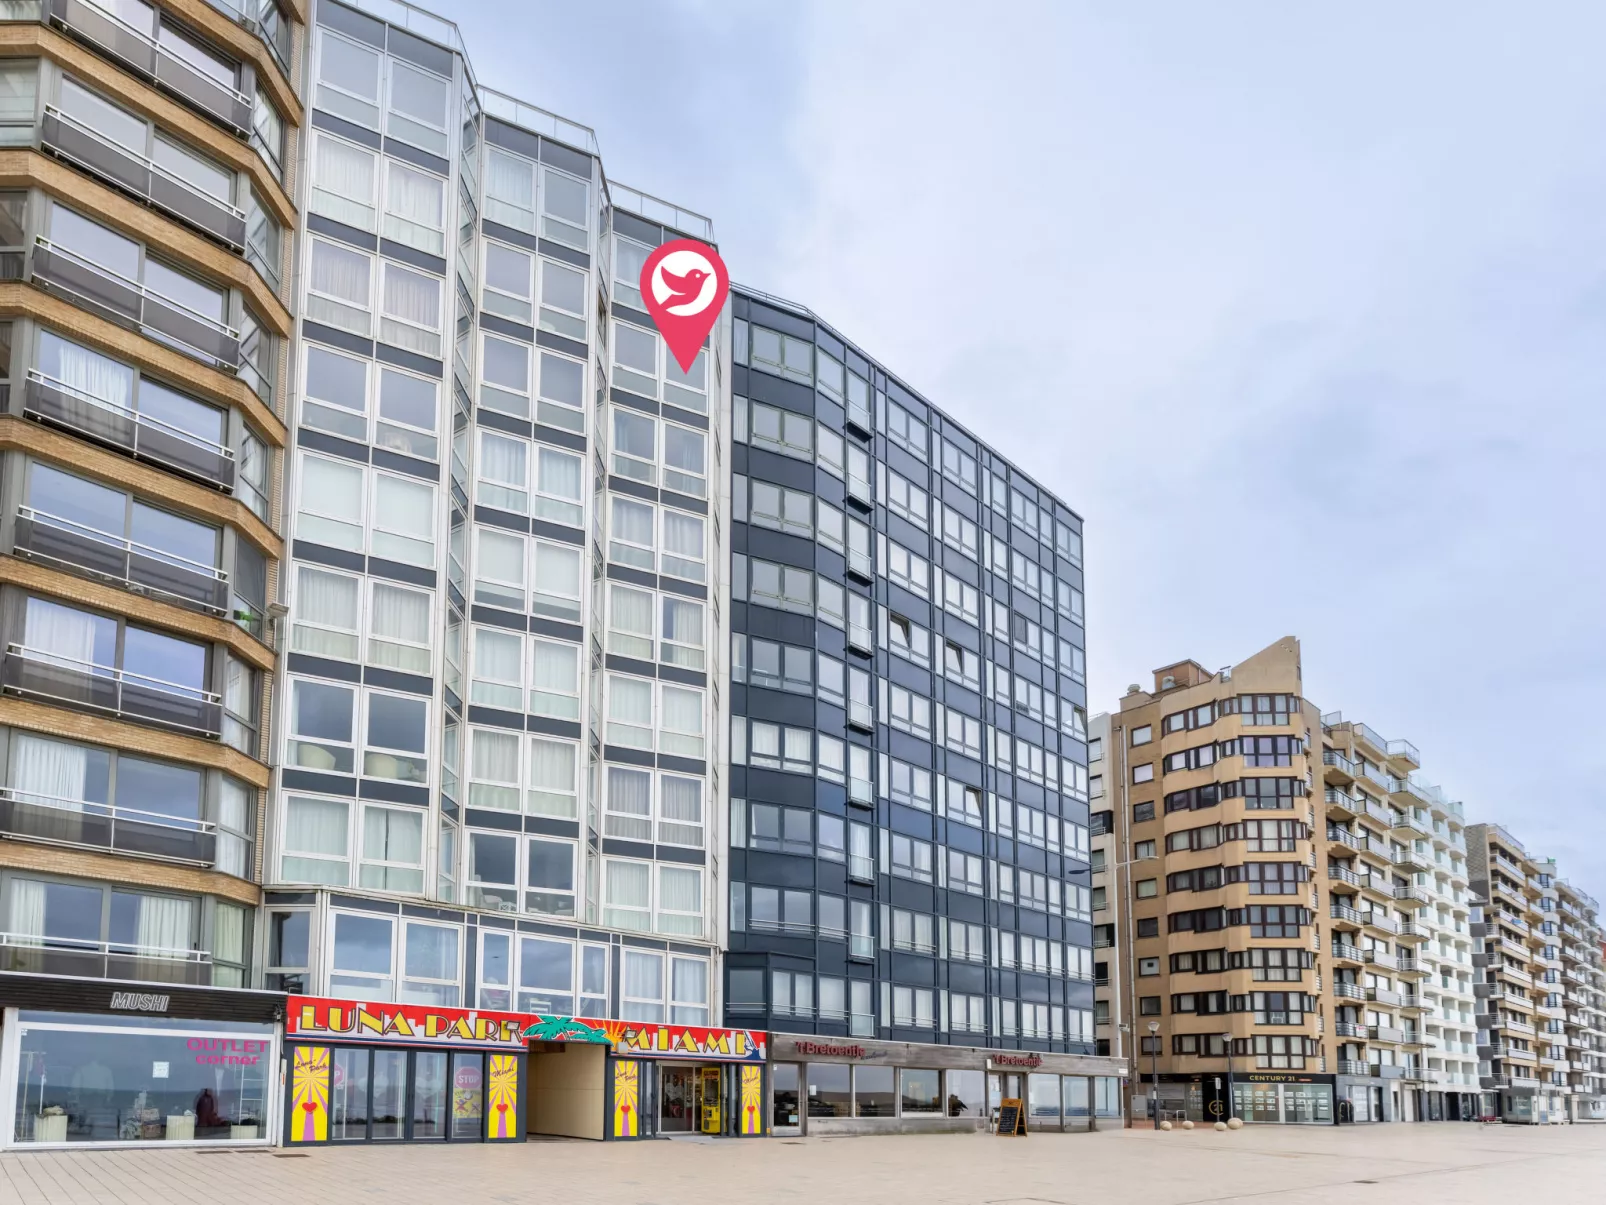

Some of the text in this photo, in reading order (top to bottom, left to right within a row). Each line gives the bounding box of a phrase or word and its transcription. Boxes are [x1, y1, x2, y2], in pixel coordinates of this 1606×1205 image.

[110, 991, 170, 1013] MUSHI
[300, 1005, 523, 1043] LUNA PARK
[186, 1037, 269, 1053] OUTLET
[624, 1025, 747, 1056] MIAMI
[195, 1054, 261, 1066] corner
[458, 1075, 480, 1085] STOP
